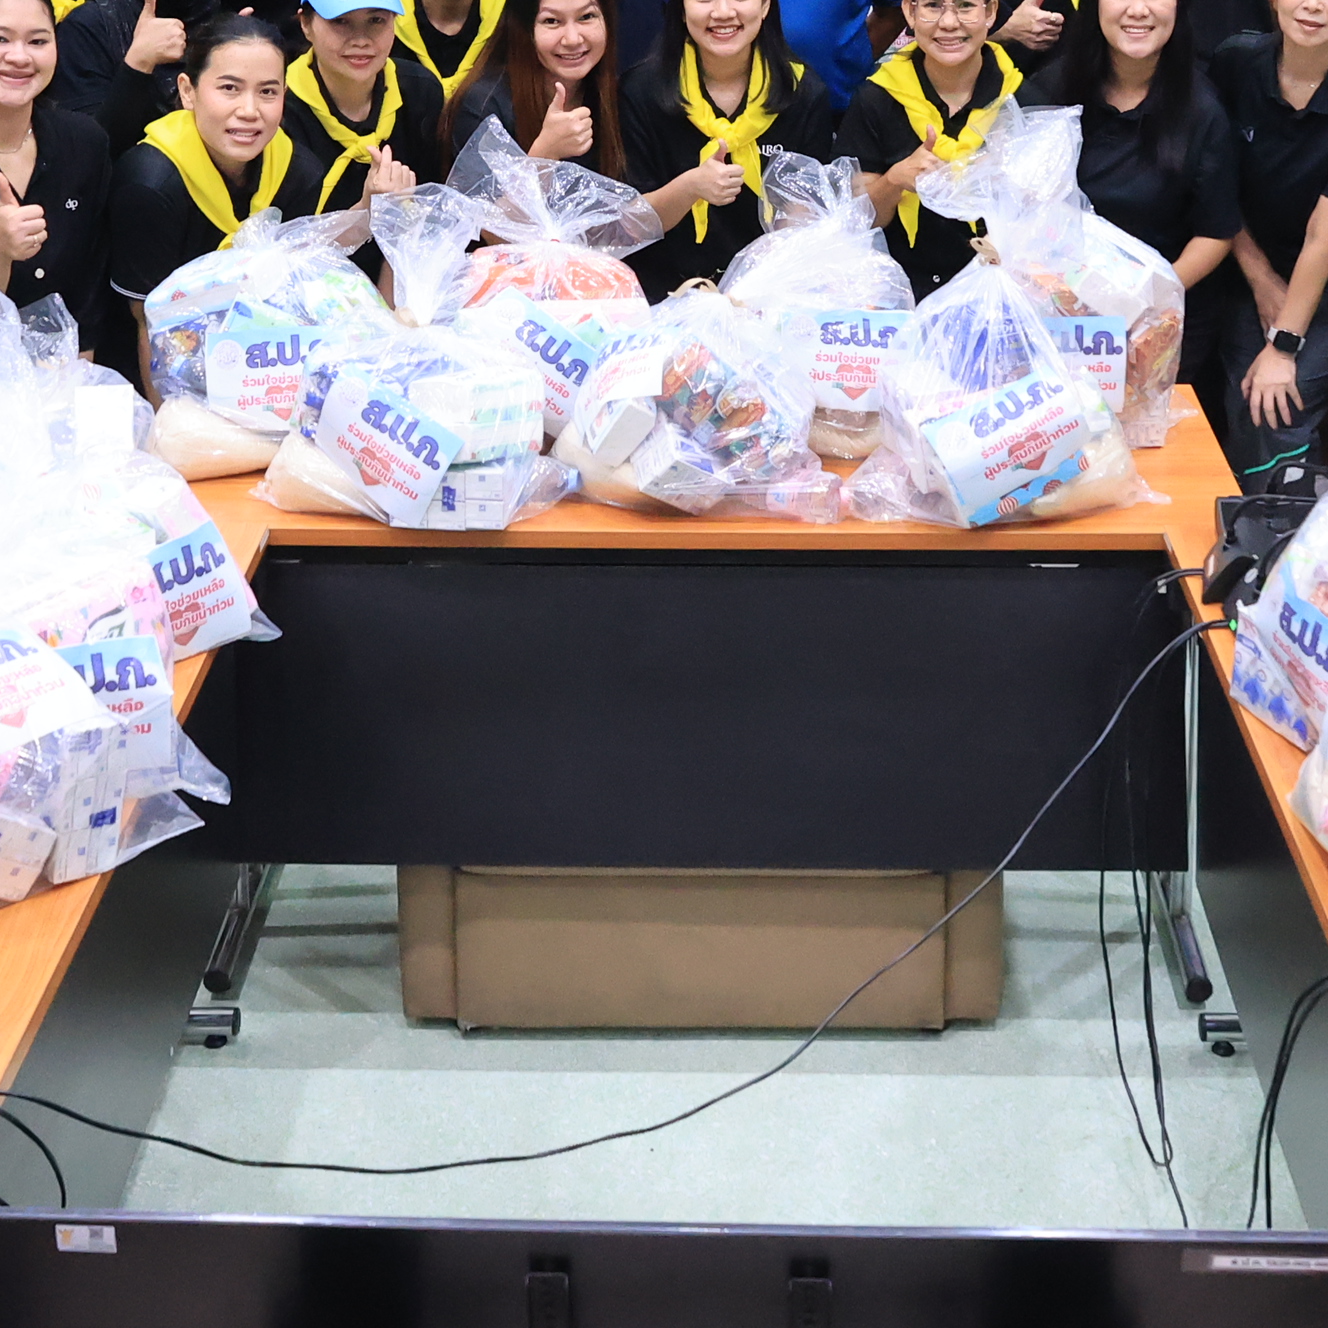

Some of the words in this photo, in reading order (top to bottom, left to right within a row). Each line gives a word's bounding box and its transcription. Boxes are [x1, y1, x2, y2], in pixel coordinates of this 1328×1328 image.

[347, 422, 422, 481] ร่วมใจช่วยเหลือ
[360, 399, 441, 471] ส.ป.ก.
[336, 434, 419, 501] ผู้ประสบภัยน้ำท่วม
[164, 577, 226, 614] ใจช่วยเหลือ
[74, 652, 158, 694] ป.ก.
